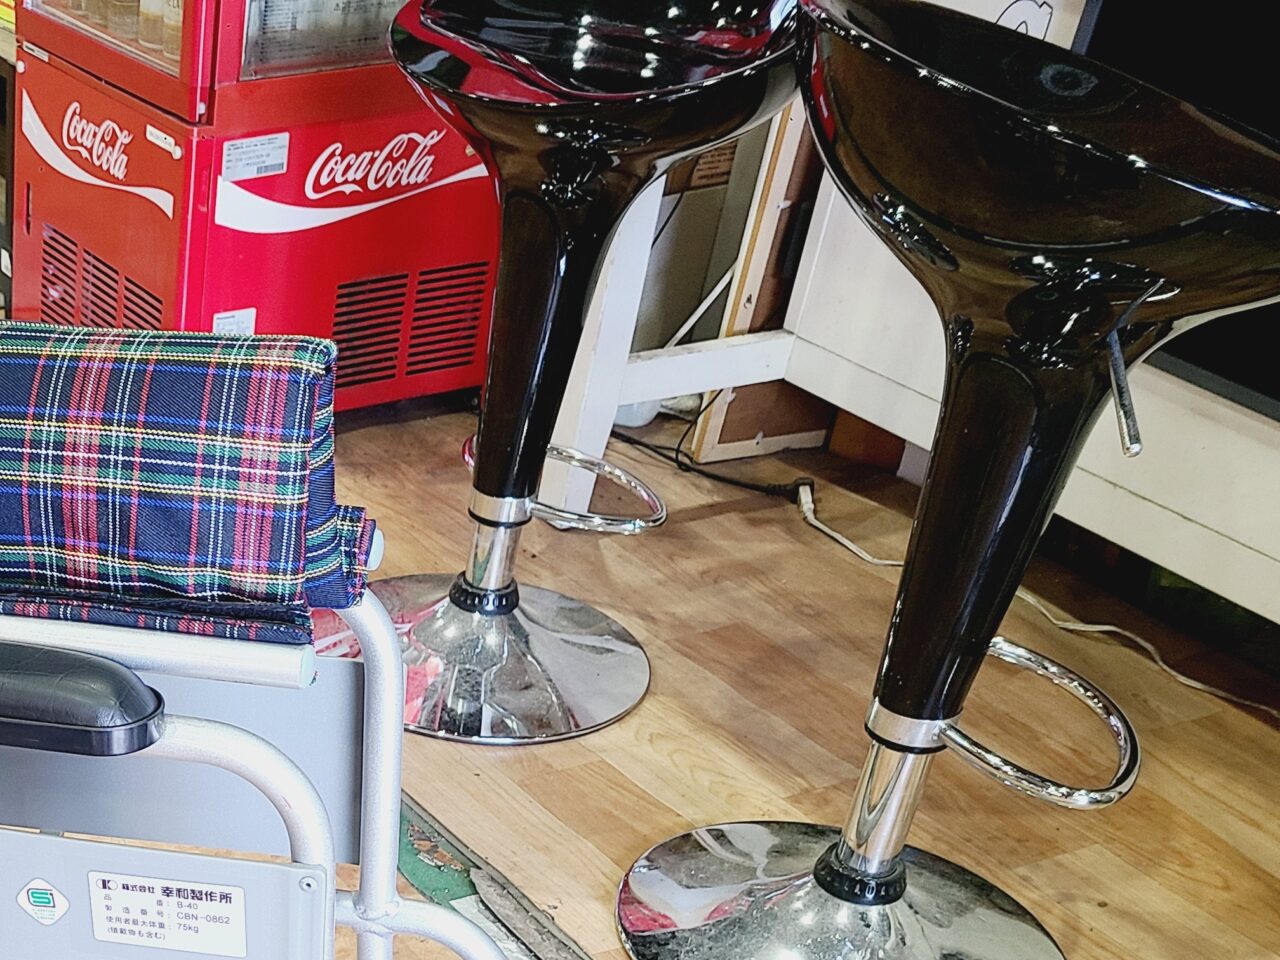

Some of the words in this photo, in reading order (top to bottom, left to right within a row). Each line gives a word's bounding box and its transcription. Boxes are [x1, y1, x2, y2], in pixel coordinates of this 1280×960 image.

[62, 101, 133, 181] Coca-Cola
[305, 128, 447, 200] Coca-Cola
[161, 886, 232, 904] 幸和製作所
[176, 922, 199, 934] 75kg
